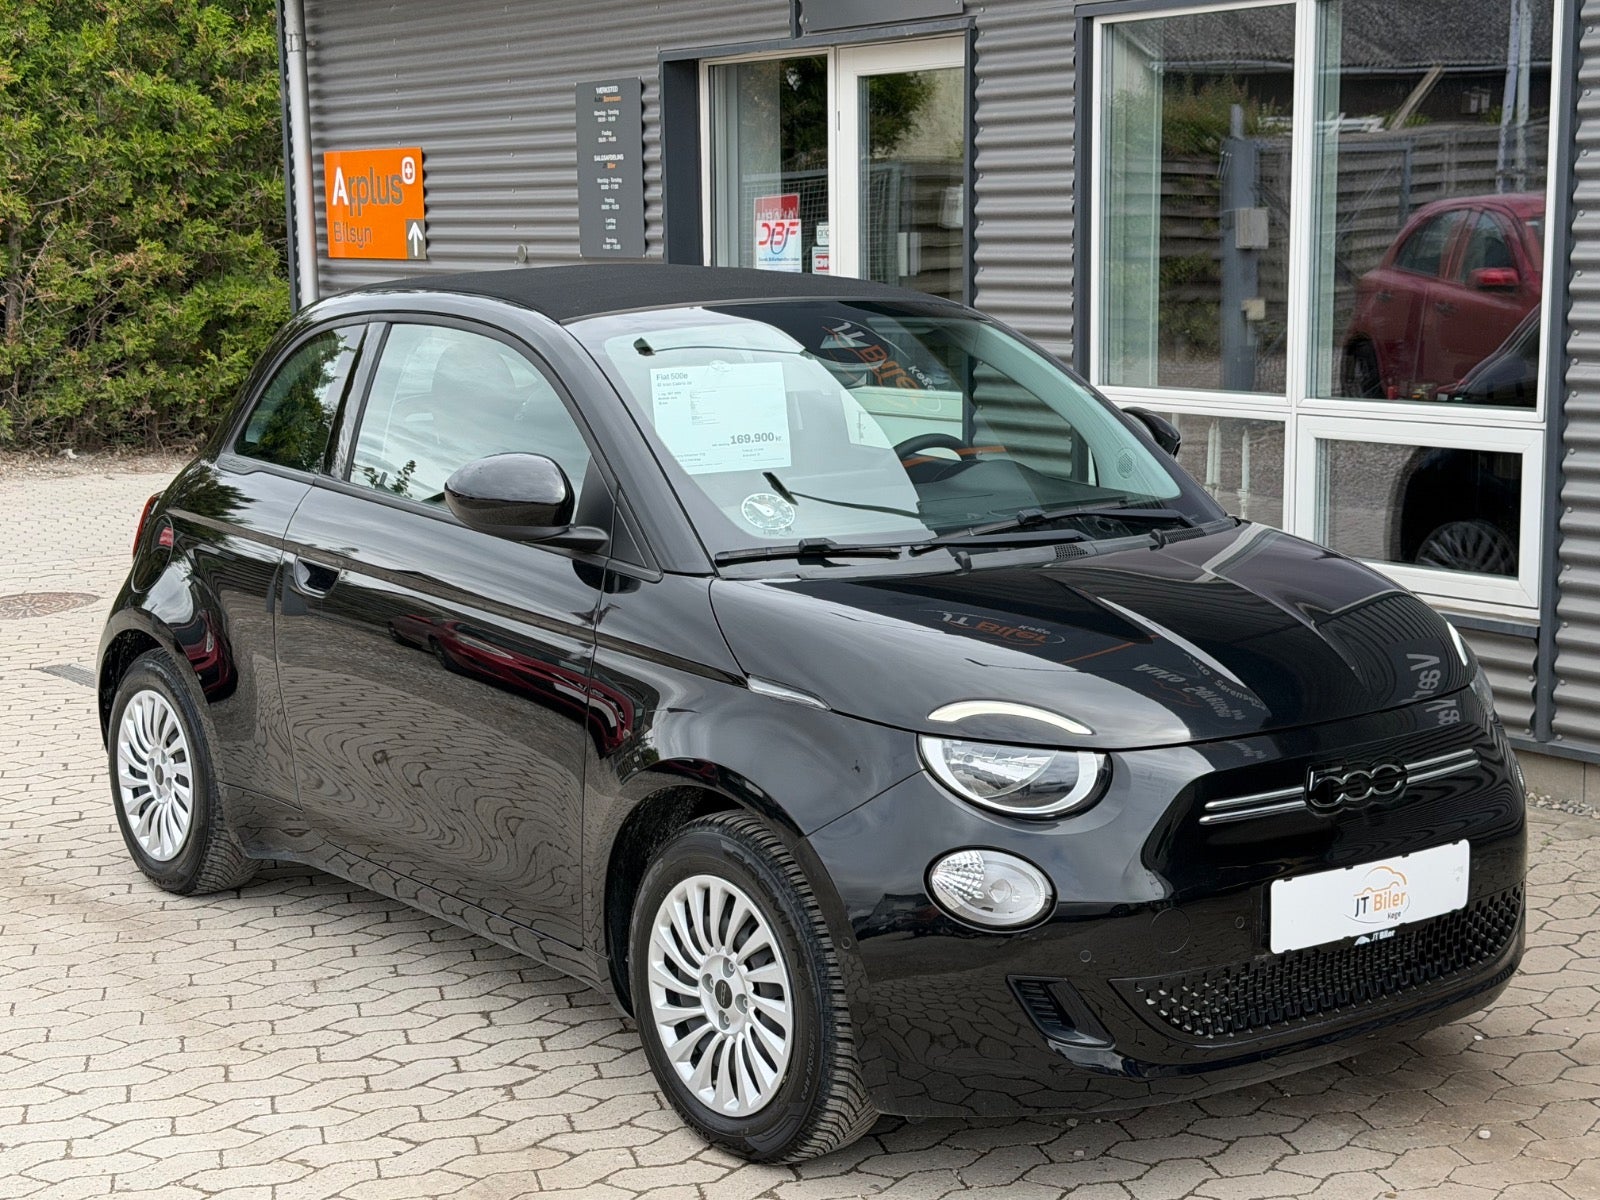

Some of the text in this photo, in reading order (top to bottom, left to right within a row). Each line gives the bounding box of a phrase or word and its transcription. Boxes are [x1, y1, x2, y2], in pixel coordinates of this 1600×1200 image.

[333, 221, 372, 249] Bilsyn
[656, 373, 669, 381] Fiat
[730, 431, 775, 445] 169.900
[1355, 890, 1407, 917] JT Biler
